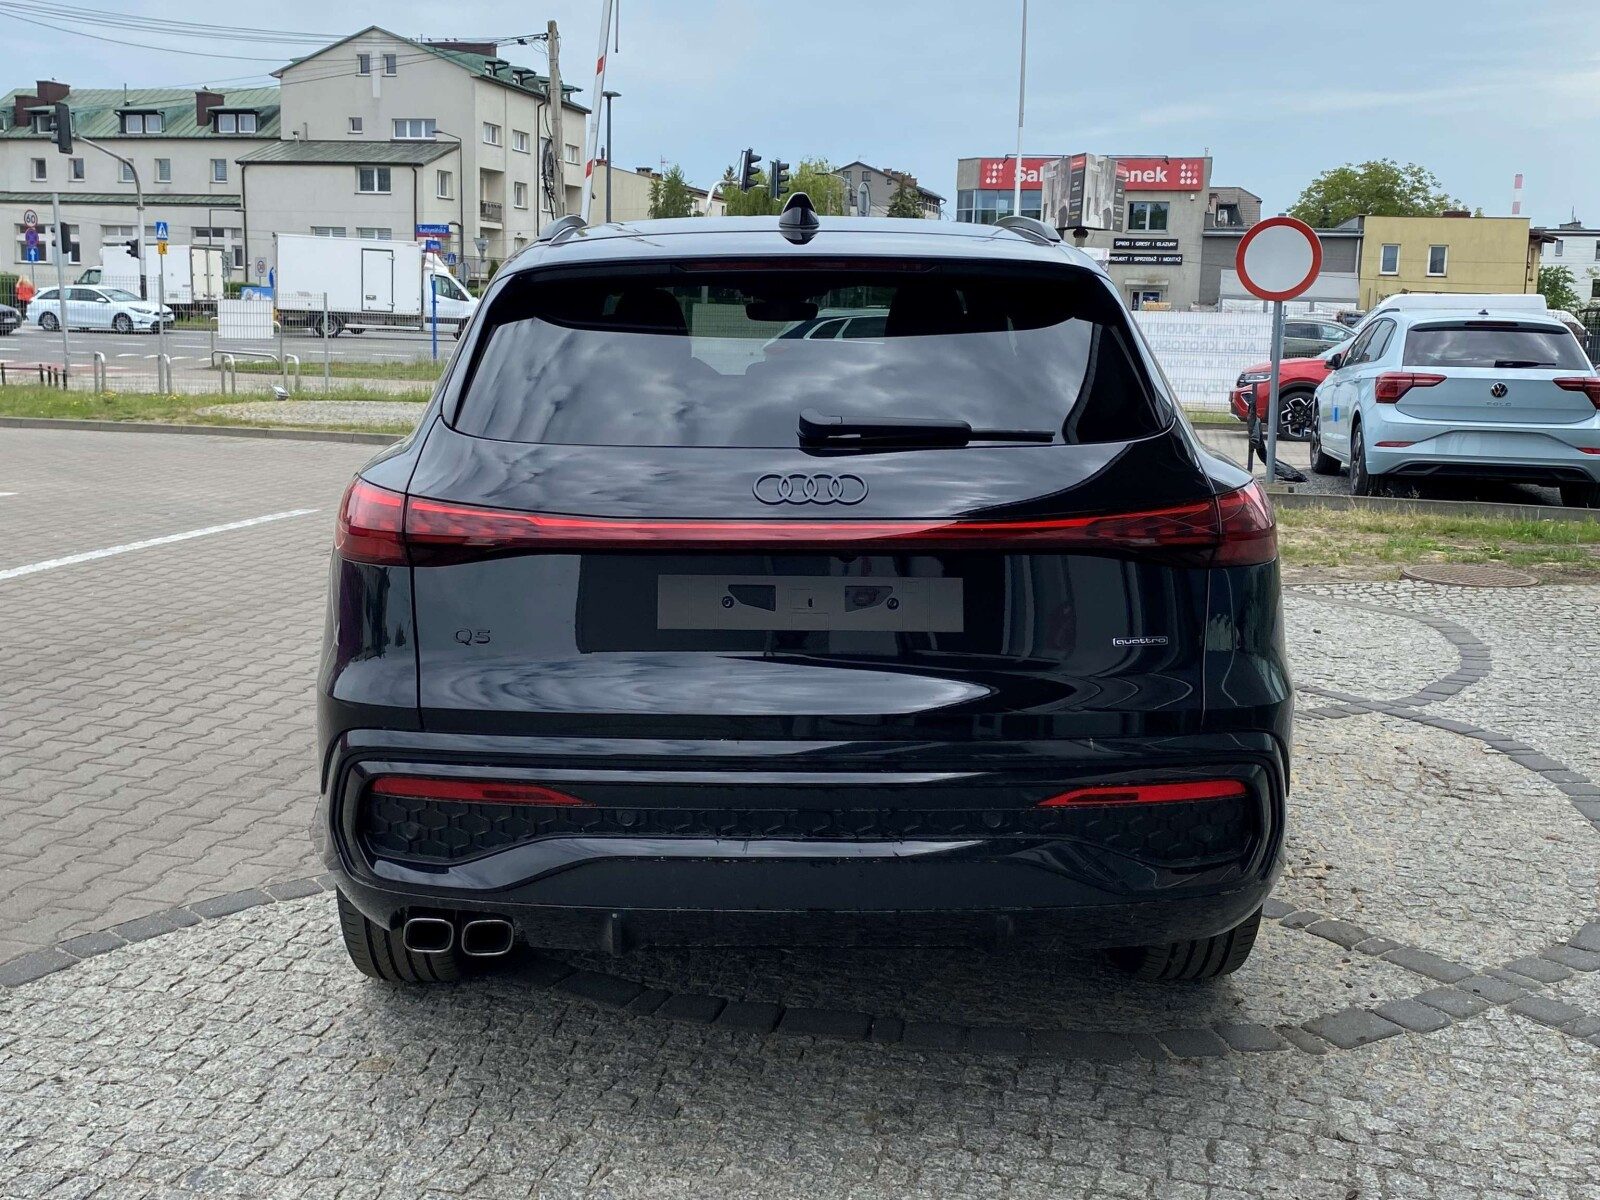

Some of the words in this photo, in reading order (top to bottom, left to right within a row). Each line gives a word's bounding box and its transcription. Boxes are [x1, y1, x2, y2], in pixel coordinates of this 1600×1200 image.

[1014, 166, 1043, 182] Sal
[26, 213, 36, 224] 60
[455, 629, 491, 646] Q5
[1116, 637, 1166, 646] quattro
